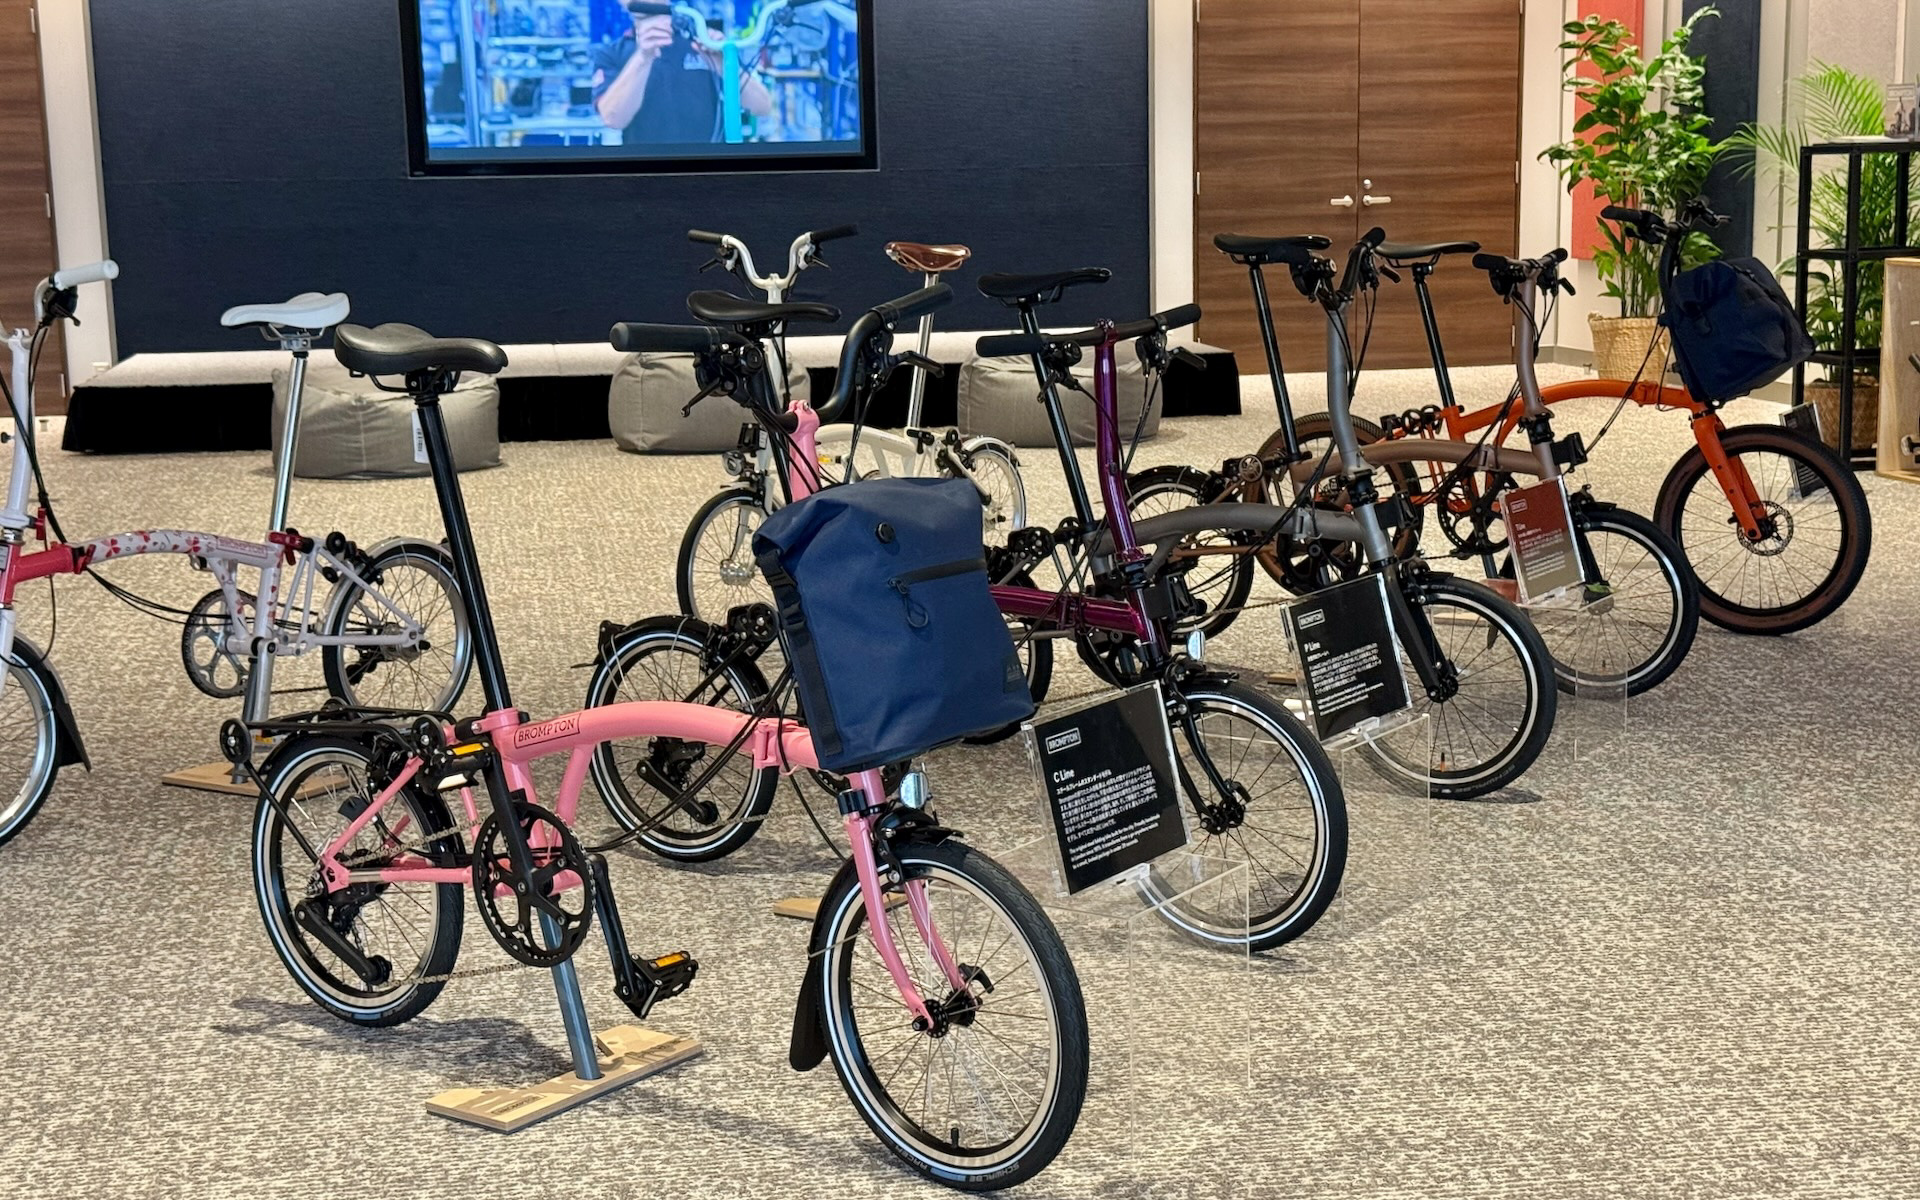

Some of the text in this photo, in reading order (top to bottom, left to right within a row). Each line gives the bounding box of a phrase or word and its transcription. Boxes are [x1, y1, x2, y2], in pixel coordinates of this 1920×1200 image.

[518, 718, 575, 742] BROMPTON
[1048, 732, 1078, 750] BROMPTON
[1053, 769, 1075, 783] C Line
[895, 1144, 1019, 1182] SCHWALBE RACER
